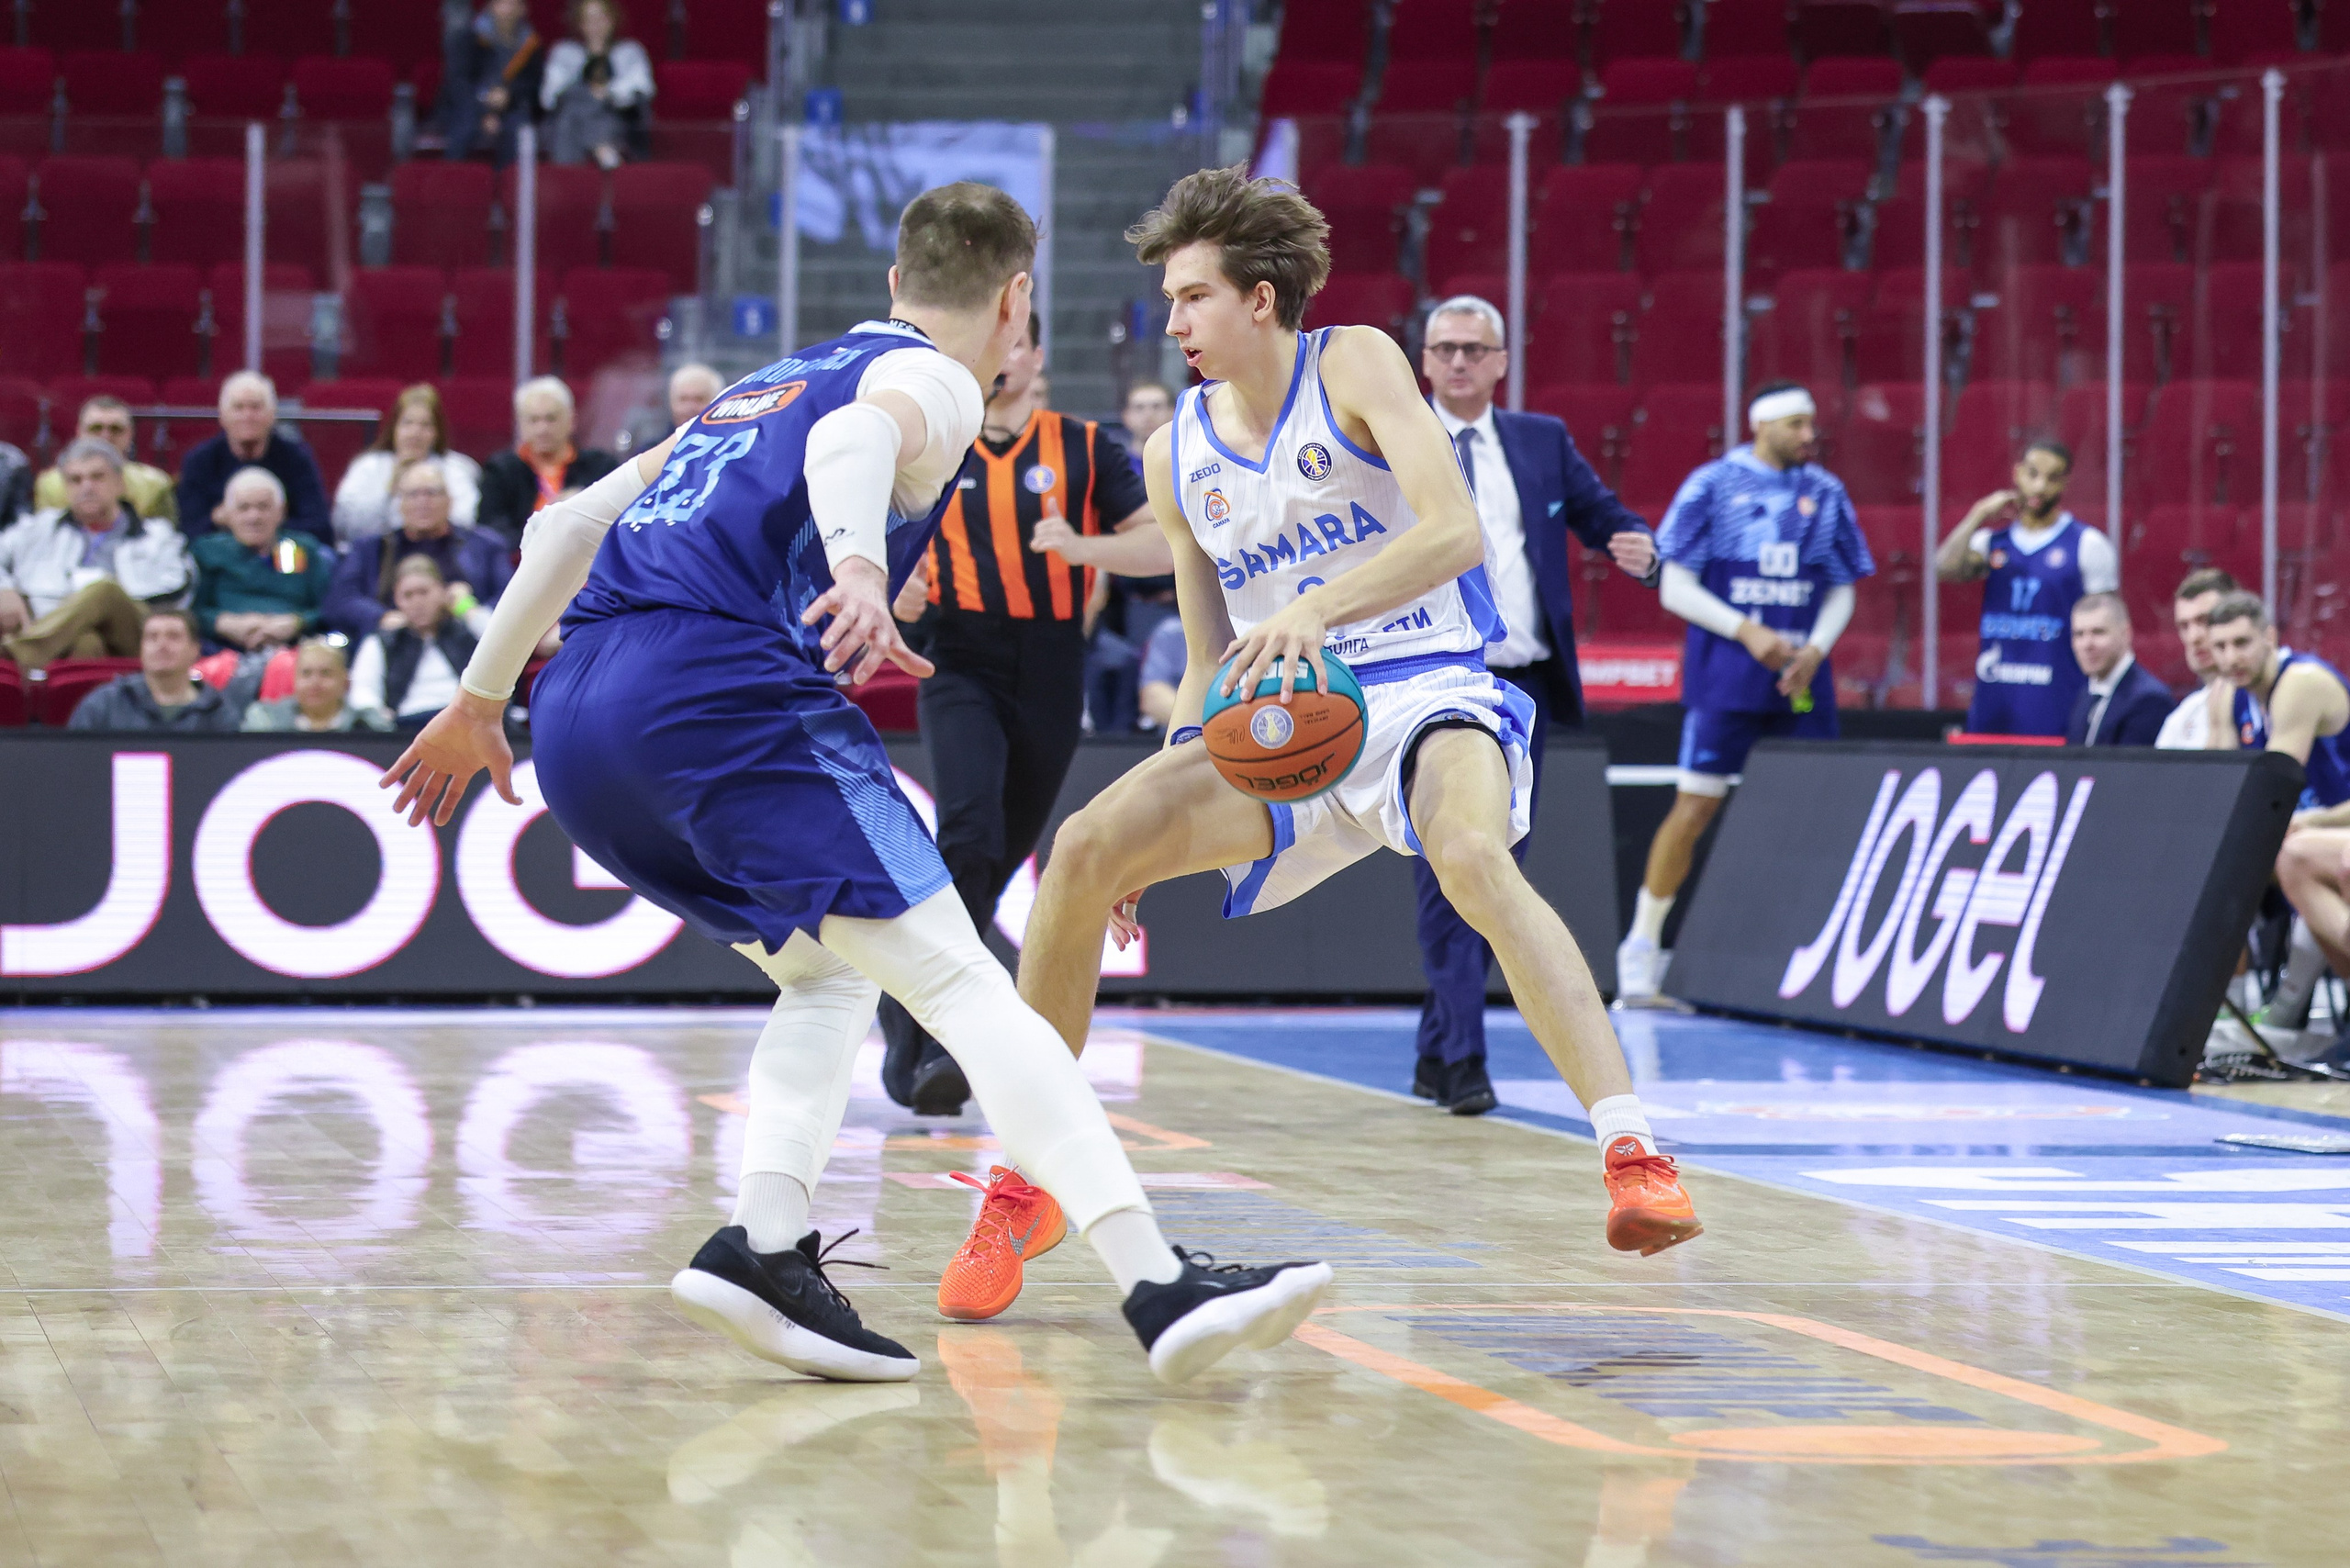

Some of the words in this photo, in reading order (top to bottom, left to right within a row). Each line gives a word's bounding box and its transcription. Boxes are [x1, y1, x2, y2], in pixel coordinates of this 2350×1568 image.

[1189, 463, 1222, 484] ZEDO
[1217, 500, 1388, 590] SAMARA
[2010, 576, 2042, 612] 17
